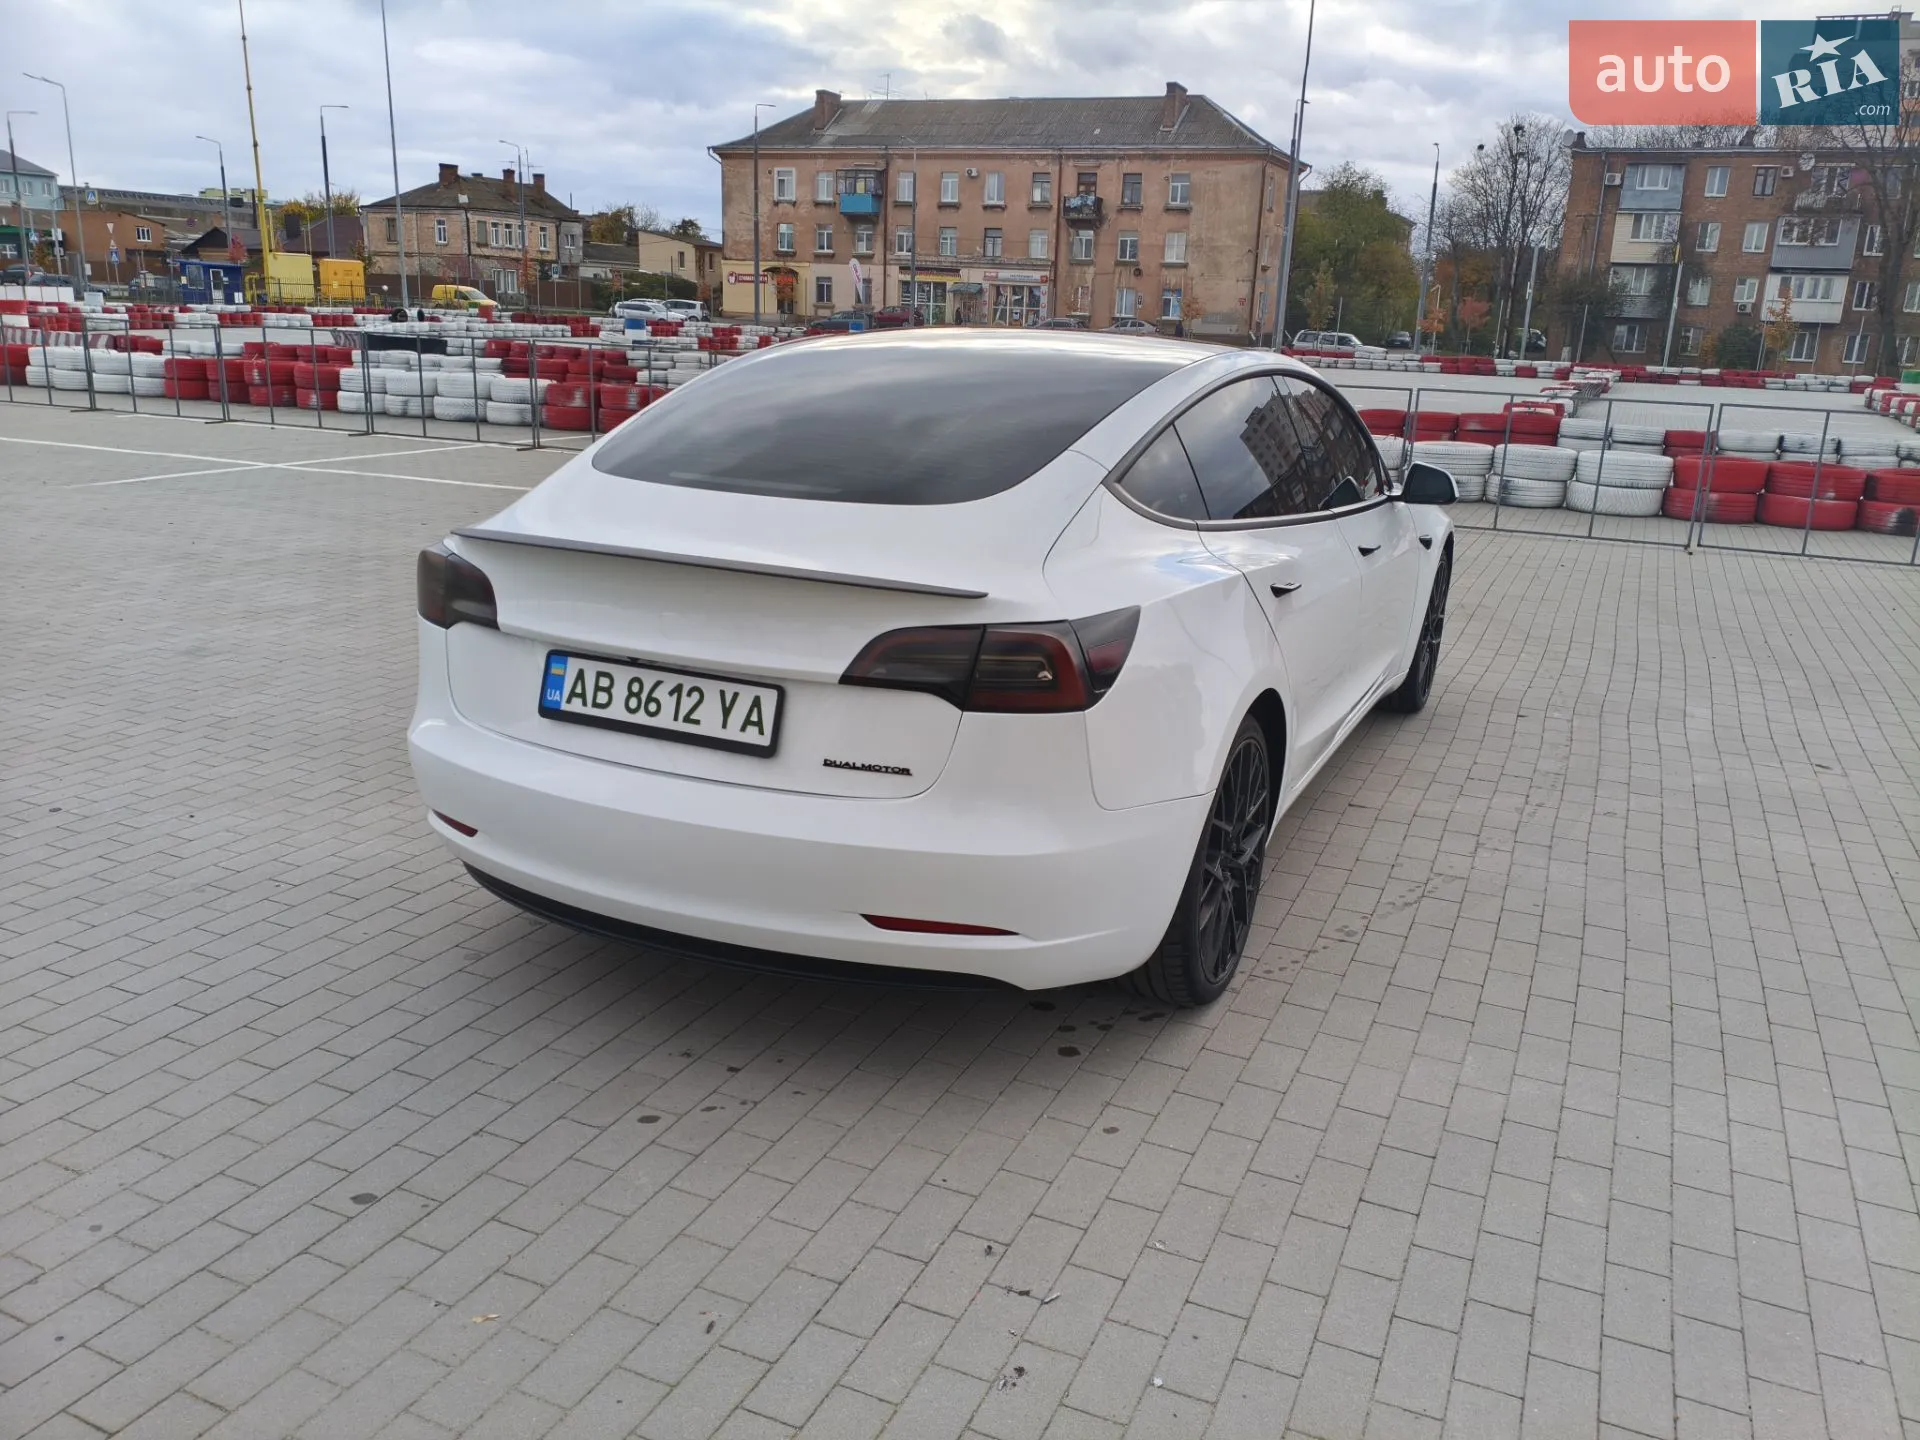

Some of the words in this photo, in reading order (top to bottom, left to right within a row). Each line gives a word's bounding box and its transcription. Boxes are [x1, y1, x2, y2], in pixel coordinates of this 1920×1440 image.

[547, 689, 561, 702] UA
[565, 667, 615, 710] AB
[623, 675, 705, 726] 8612
[718, 688, 766, 736] YA
